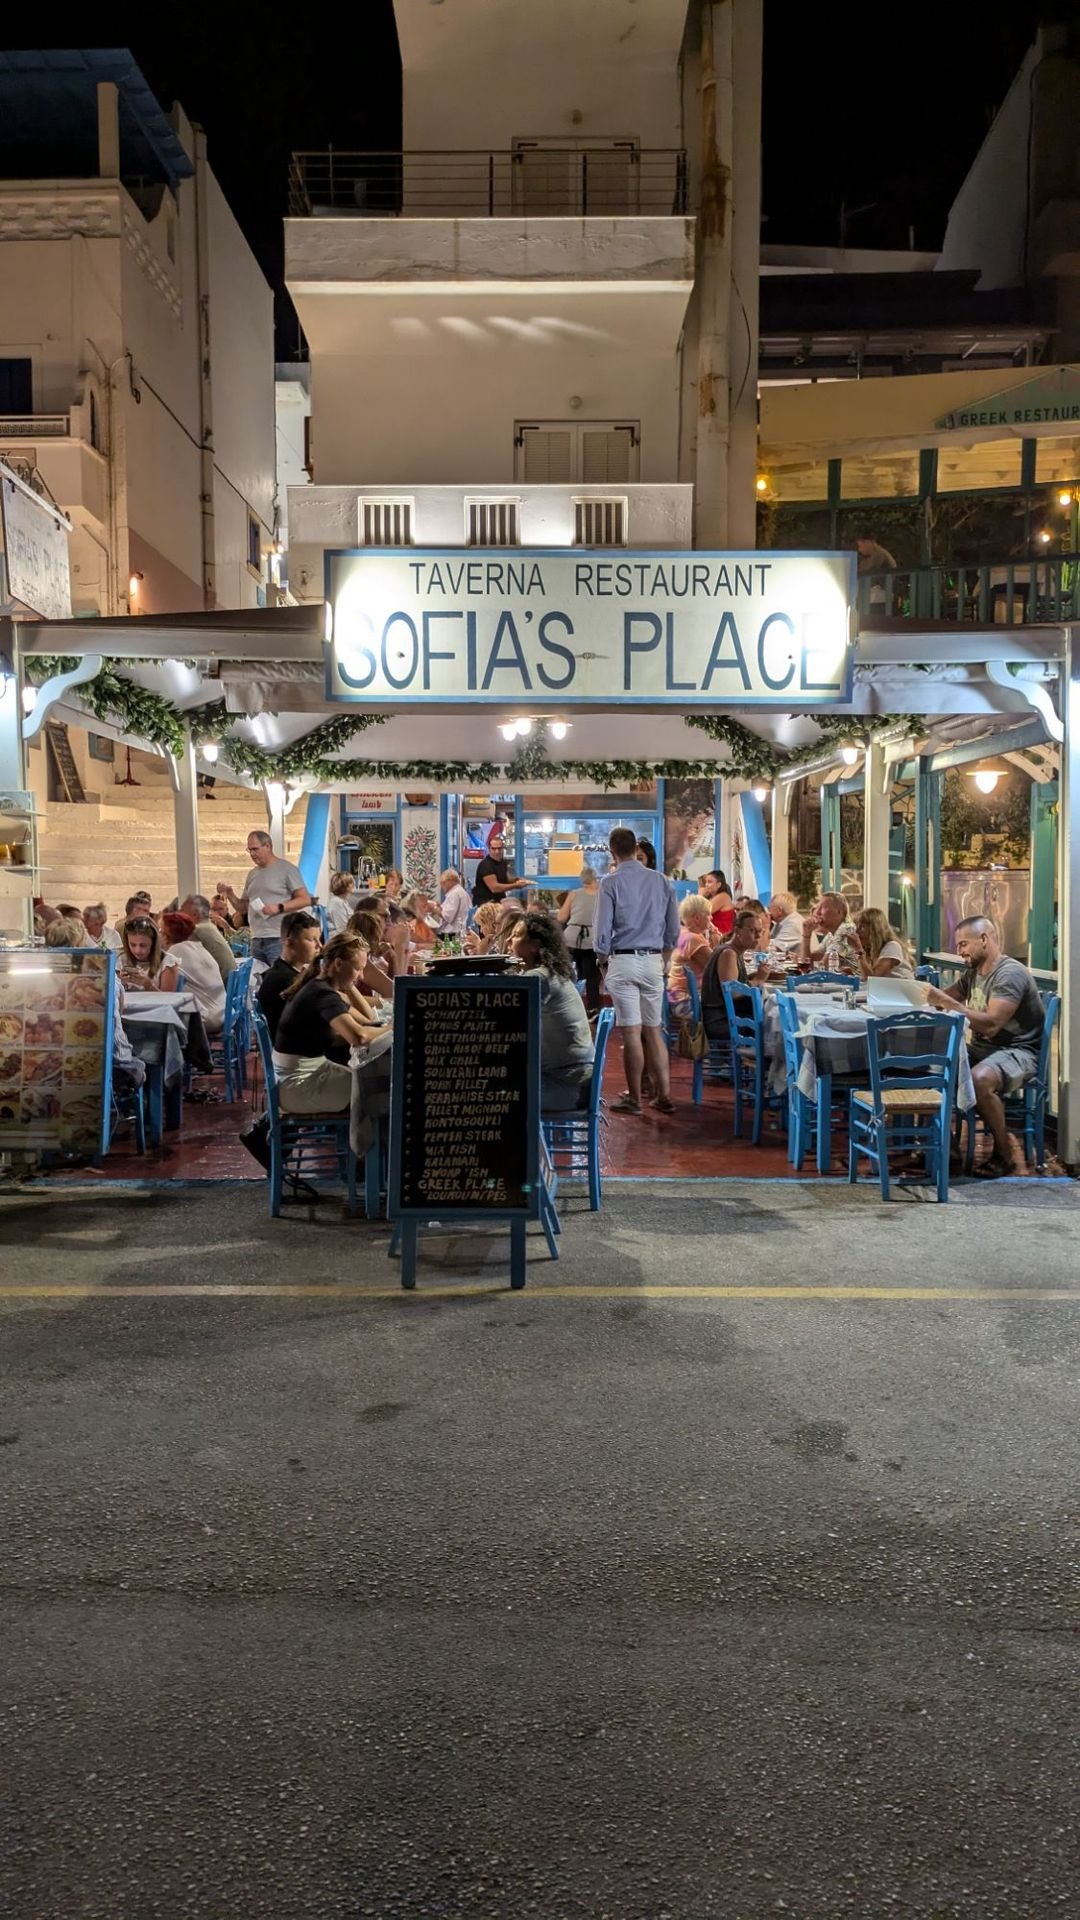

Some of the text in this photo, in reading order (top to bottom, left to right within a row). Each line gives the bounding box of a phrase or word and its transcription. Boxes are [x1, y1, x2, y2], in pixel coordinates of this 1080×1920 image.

[960, 405, 1080, 426] GREEK RESTAUR
[409, 563, 772, 597] TAVERNA RESTAURANT
[337, 610, 841, 691] SOFIA'S PLACE
[416, 992, 521, 1008] SOFIA'S PLACE
[423, 1009, 488, 1020] SCHNITZEL
[463, 1021, 498, 1031] PLATE
[471, 1044, 484, 1054] OF
[485, 1044, 511, 1055] BEEF
[424, 1055, 480, 1066] MIX GRILL
[477, 1066, 508, 1078] LAMB
[454, 1079, 489, 1090] FILLET
[485, 1090, 520, 1102] STEAK
[424, 1103, 510, 1117] FILLET MIGNION
[424, 1115, 502, 1129] KONTOSOUVLI
[423, 1129, 502, 1143] PEPPER STEAK
[425, 1144, 477, 1156] MIX FISH
[417, 1178, 461, 1191] GREEK
